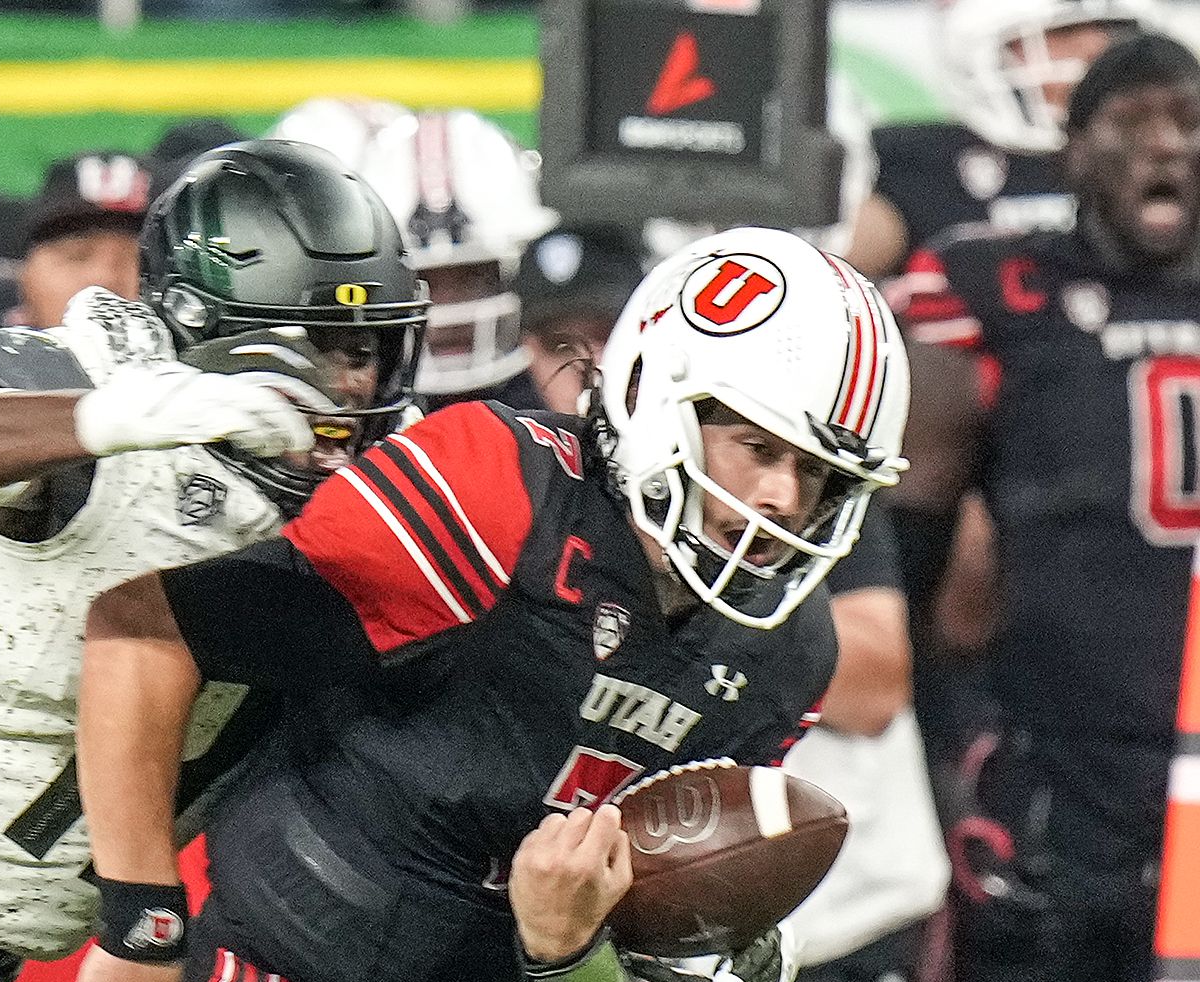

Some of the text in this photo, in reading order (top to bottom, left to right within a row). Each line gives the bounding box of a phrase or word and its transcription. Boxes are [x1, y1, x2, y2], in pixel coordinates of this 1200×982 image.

[693, 259, 778, 326] U
[999, 256, 1048, 315] C
[515, 416, 585, 482] 7
[555, 534, 594, 605] C
[579, 673, 702, 753] UTAH
